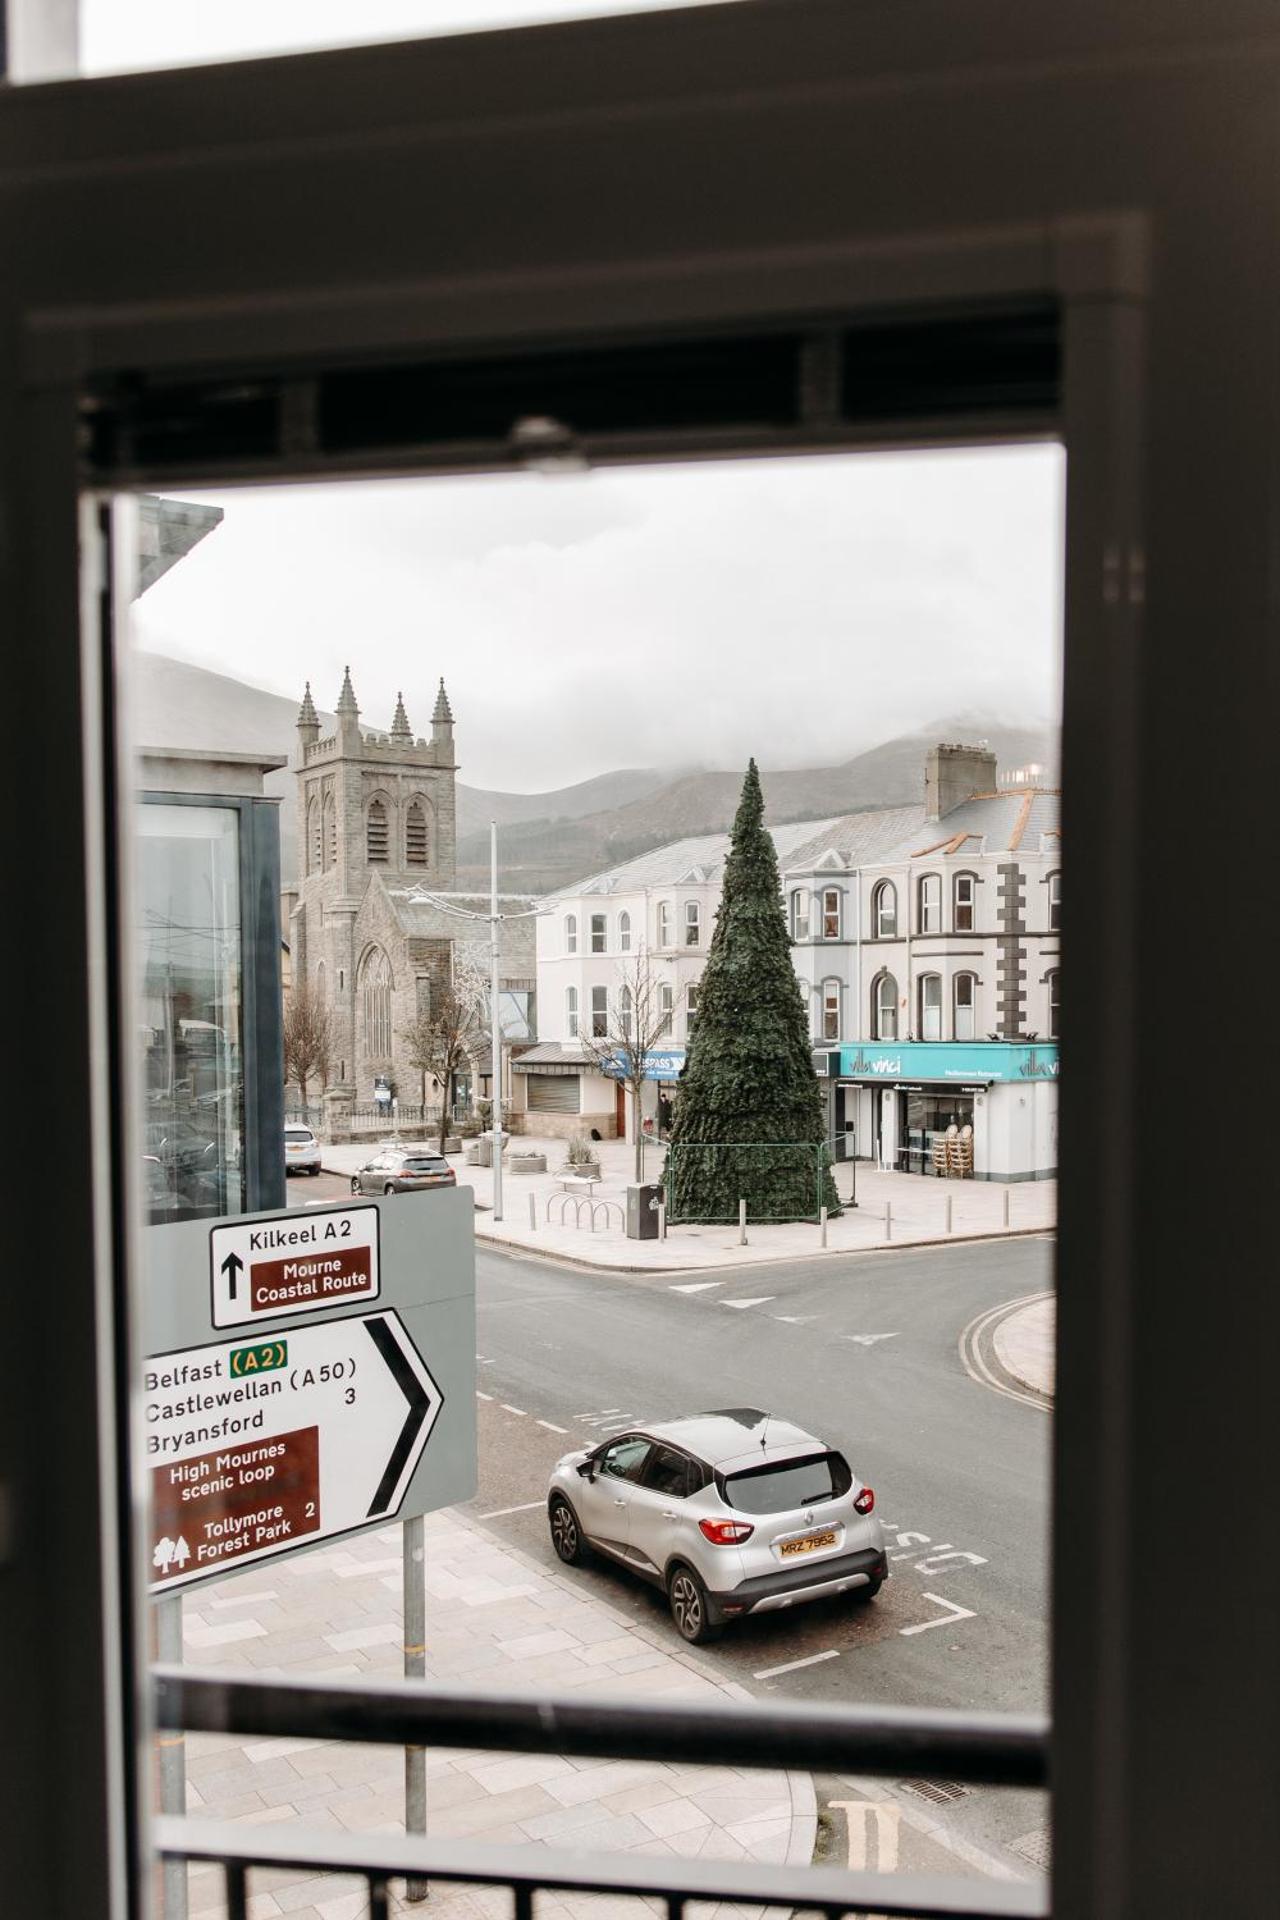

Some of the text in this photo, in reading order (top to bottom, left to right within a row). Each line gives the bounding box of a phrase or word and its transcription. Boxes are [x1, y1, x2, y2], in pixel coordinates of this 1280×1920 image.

[872, 1055, 901, 1074] vinci
[249, 1220, 352, 1251] Kilkeel A2
[256, 1271, 367, 1303] Coastal Route
[283, 1259, 341, 1280] Mourne
[145, 1344, 285, 1391] Belfast (A2)
[146, 1358, 356, 1423] Castlewellan (A50)
[344, 1388, 356, 1406] 3
[147, 1411, 263, 1454] Bryansford
[170, 1442, 286, 1485] High Mournes
[182, 1463, 275, 1501] scenic loop
[204, 1502, 315, 1538] Tollymore 2
[197, 1520, 291, 1561] Forest Park
[781, 1534, 835, 1555] MRZ 7952
